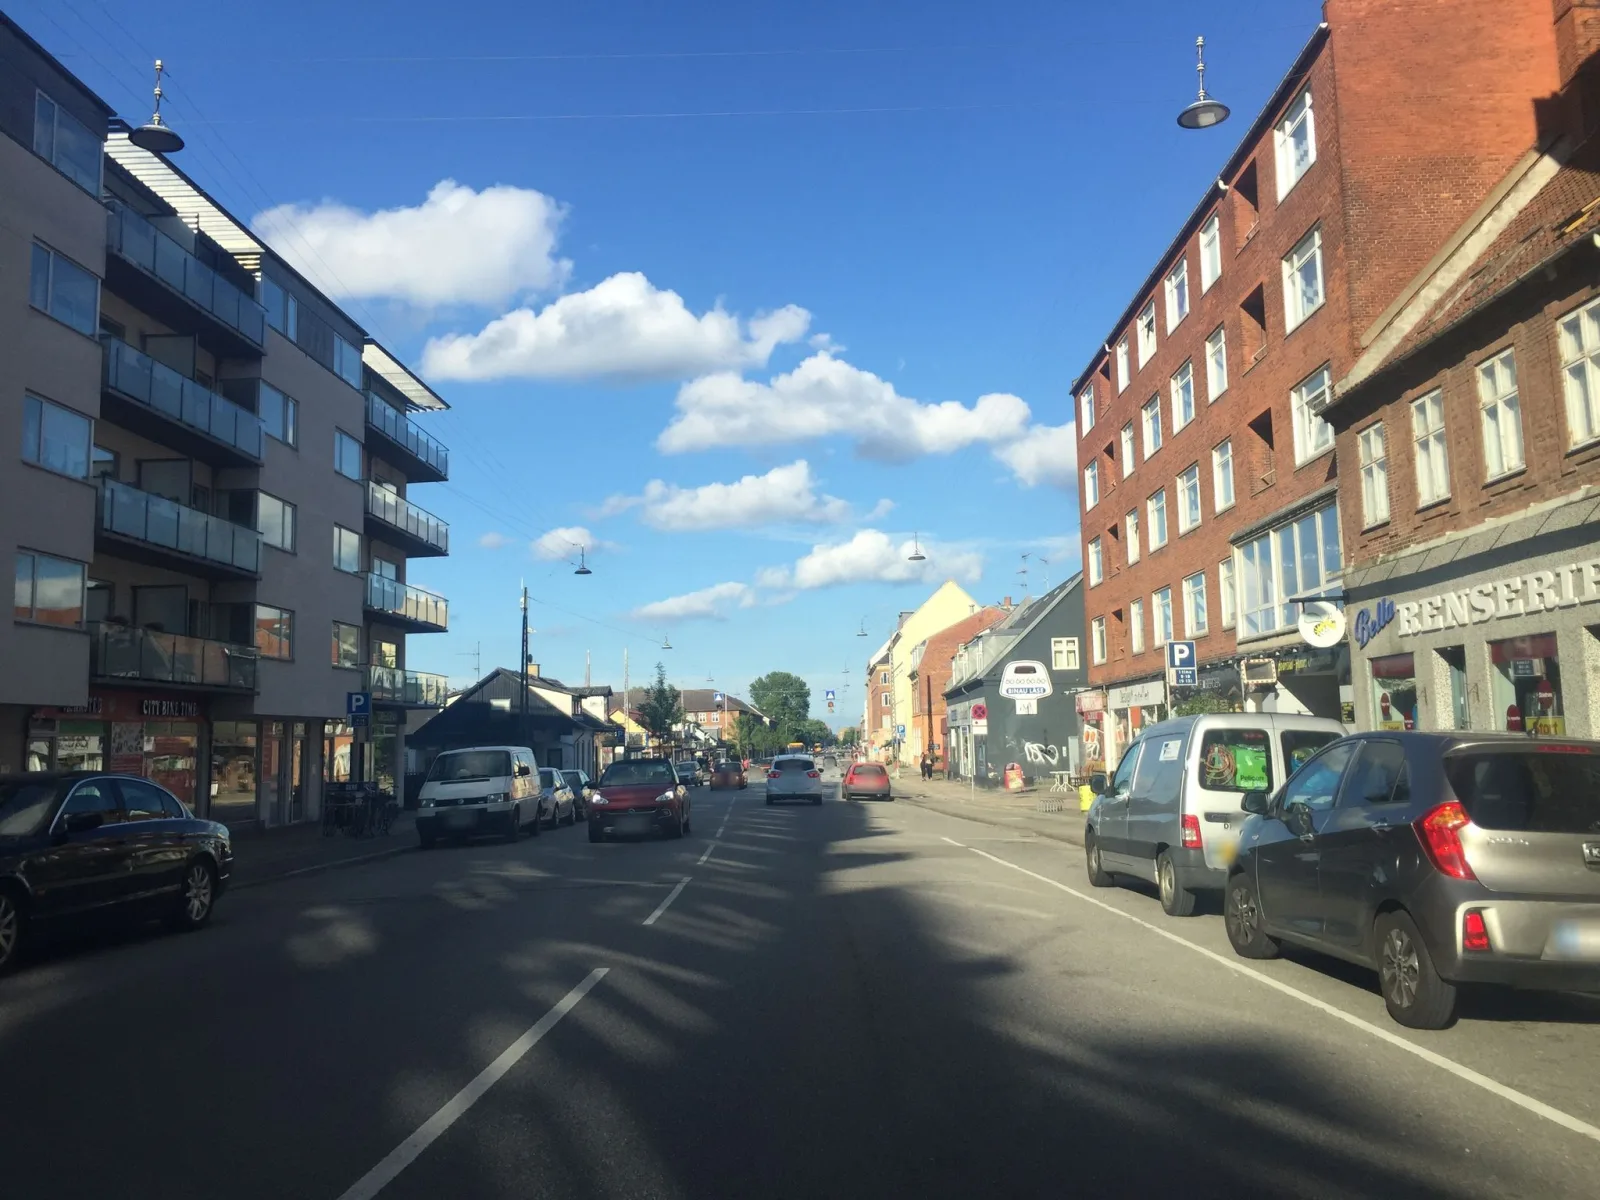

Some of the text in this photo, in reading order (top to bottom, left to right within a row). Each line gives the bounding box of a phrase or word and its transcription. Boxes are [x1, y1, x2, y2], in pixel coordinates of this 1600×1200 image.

[1173, 644, 1190, 666] P
[142, 699, 161, 716] CITY
[162, 700, 179, 716] BIKE
[352, 694, 365, 712] P
